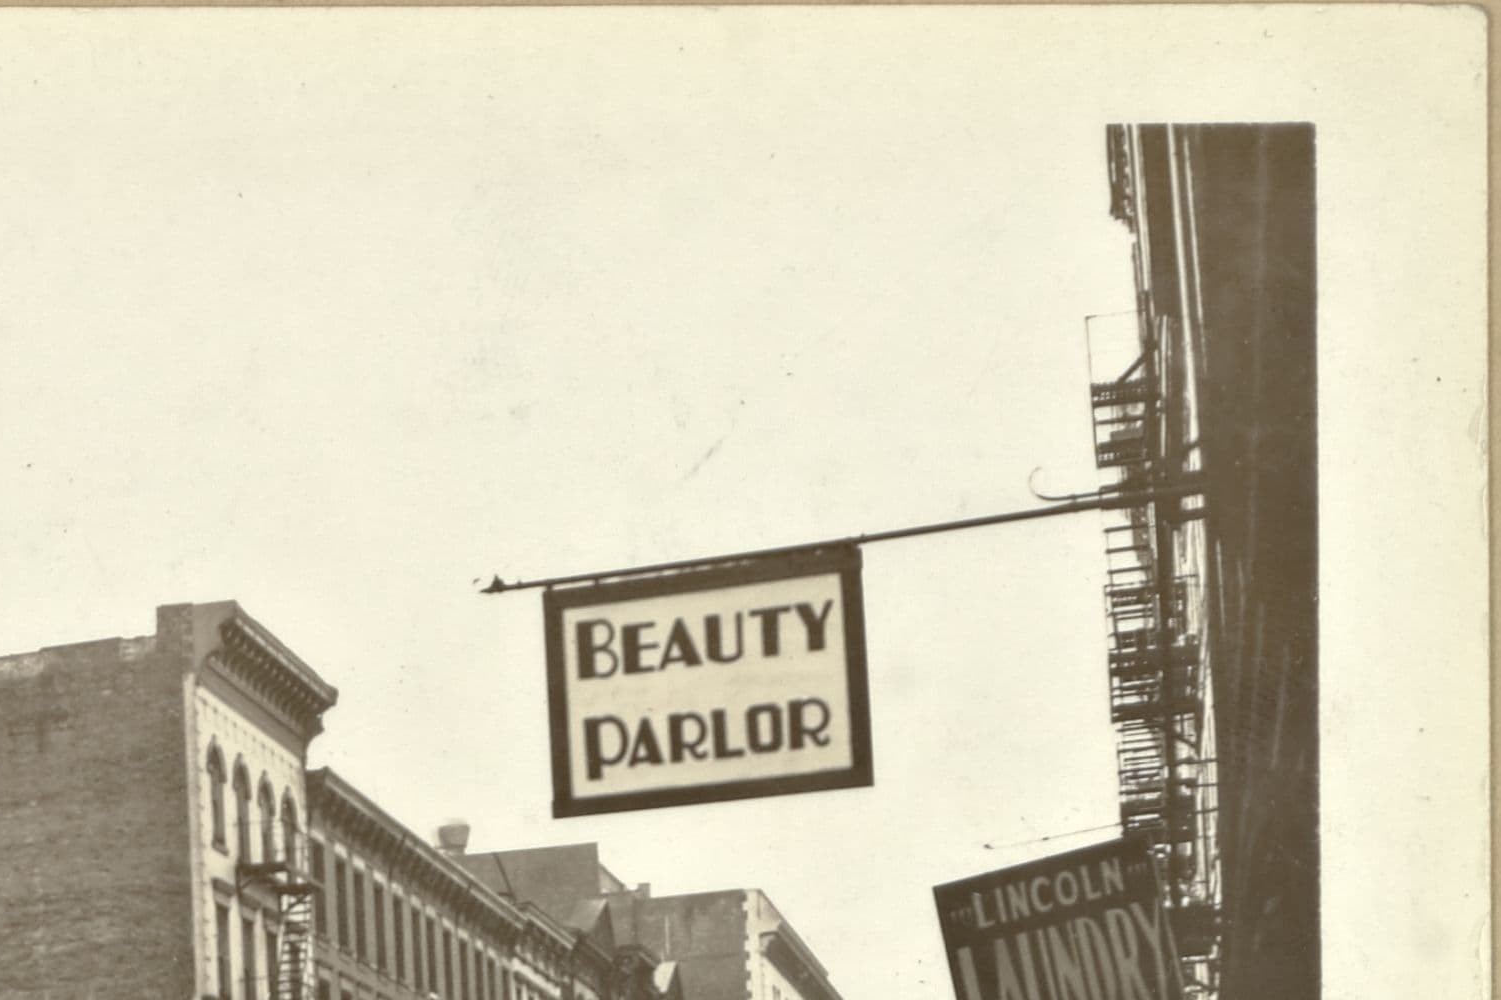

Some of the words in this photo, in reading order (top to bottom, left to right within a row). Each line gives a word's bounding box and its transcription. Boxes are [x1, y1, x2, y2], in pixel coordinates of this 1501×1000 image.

[575, 599, 834, 681] BEAUTY
[584, 697, 832, 780] PARLOR
[971, 857, 1125, 929] LINCOLN
